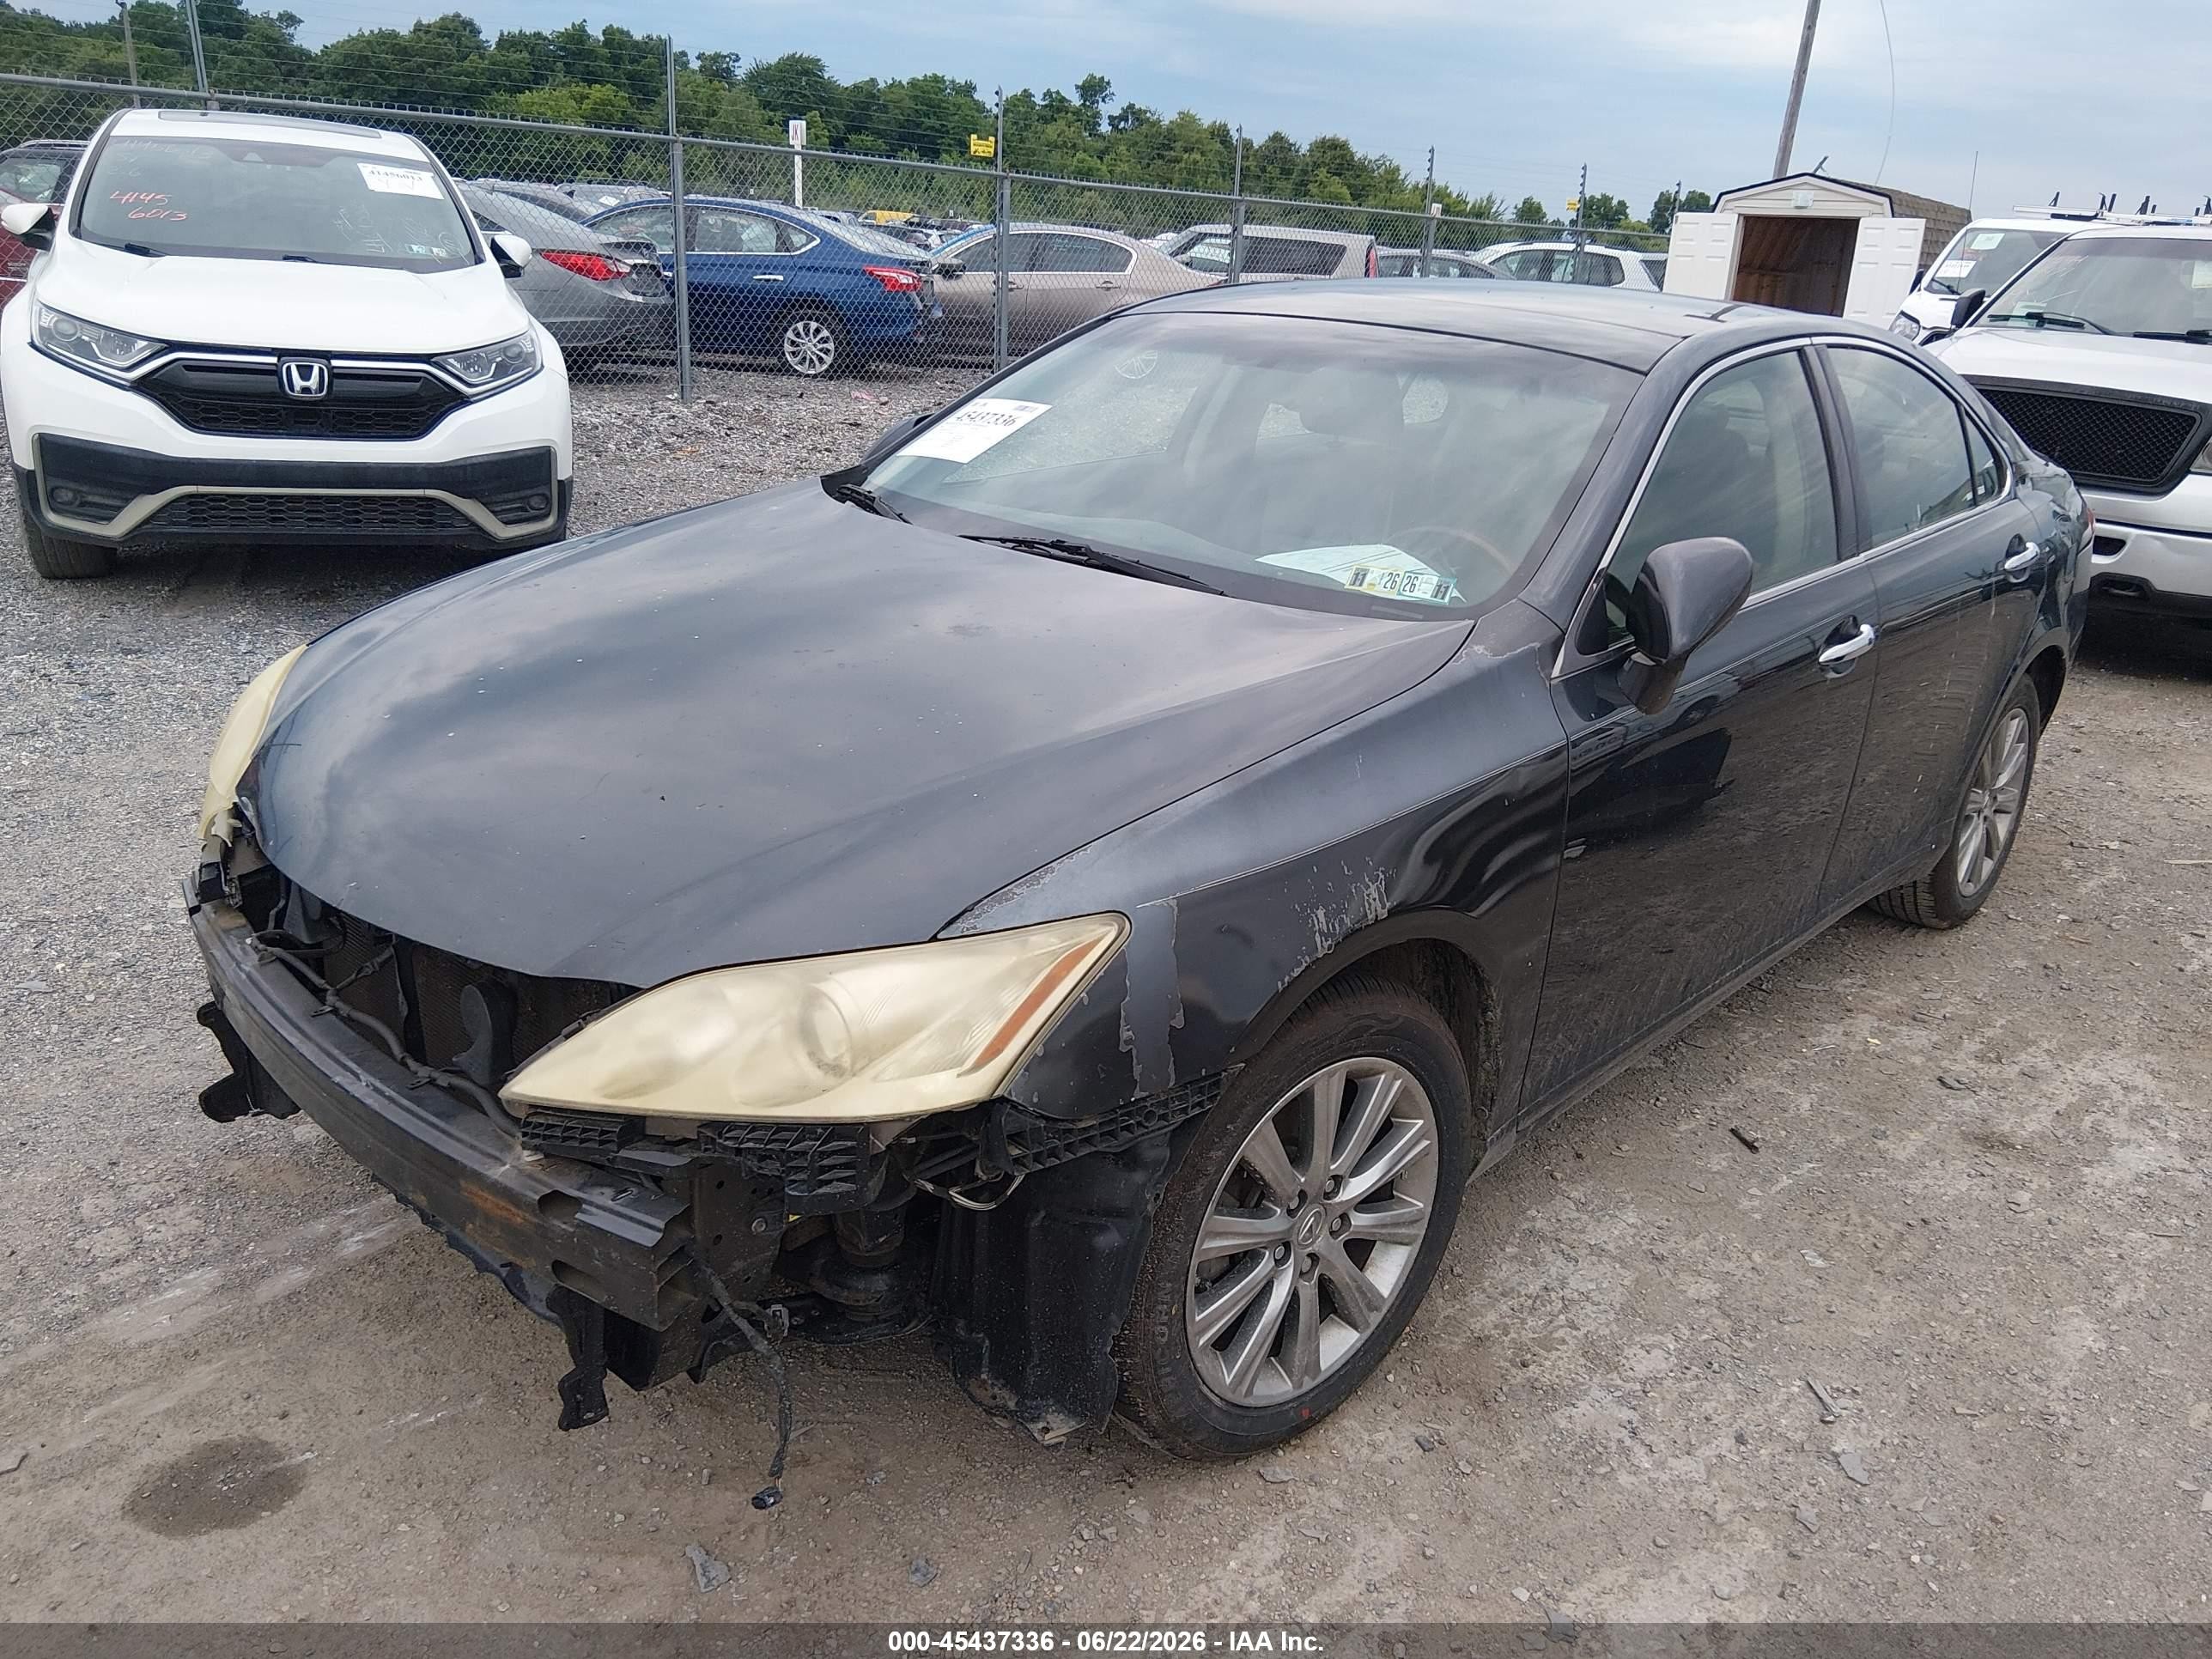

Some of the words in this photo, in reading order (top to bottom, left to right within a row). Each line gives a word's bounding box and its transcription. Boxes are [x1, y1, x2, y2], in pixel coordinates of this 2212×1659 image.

[792, 124, 799, 141] JK
[110, 191, 172, 206] 4145
[128, 206, 188, 221] 6013
[1383, 571, 1400, 590] 26
[1402, 575, 1419, 593] 26
[1431, 584, 1450, 600] 11
